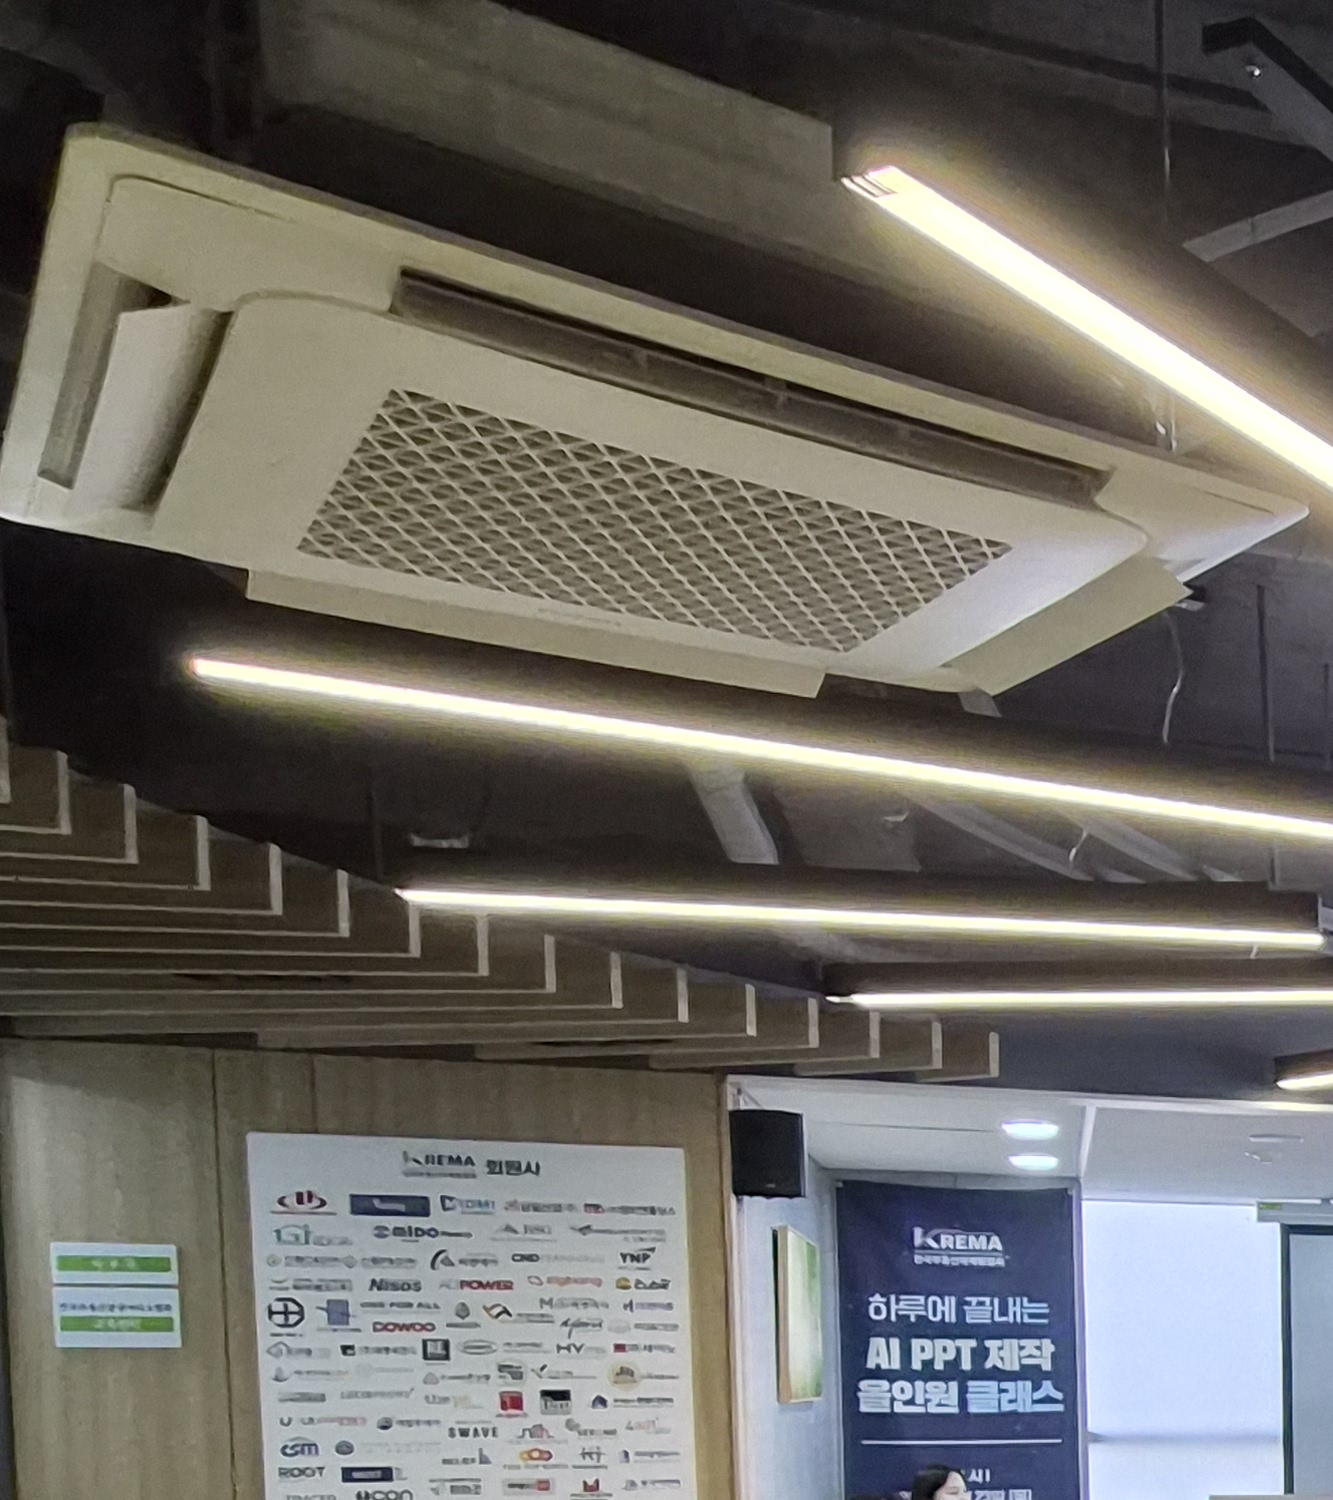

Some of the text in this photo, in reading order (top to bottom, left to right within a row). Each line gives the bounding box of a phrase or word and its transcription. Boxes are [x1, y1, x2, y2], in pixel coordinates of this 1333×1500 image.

[912, 1226, 1004, 1250] KREMA
[868, 1293, 1050, 1324] 하루에 끝내는
[866, 1337, 1055, 1371] AI PPT 제작
[857, 1380, 1064, 1413] 올인원 클래스
